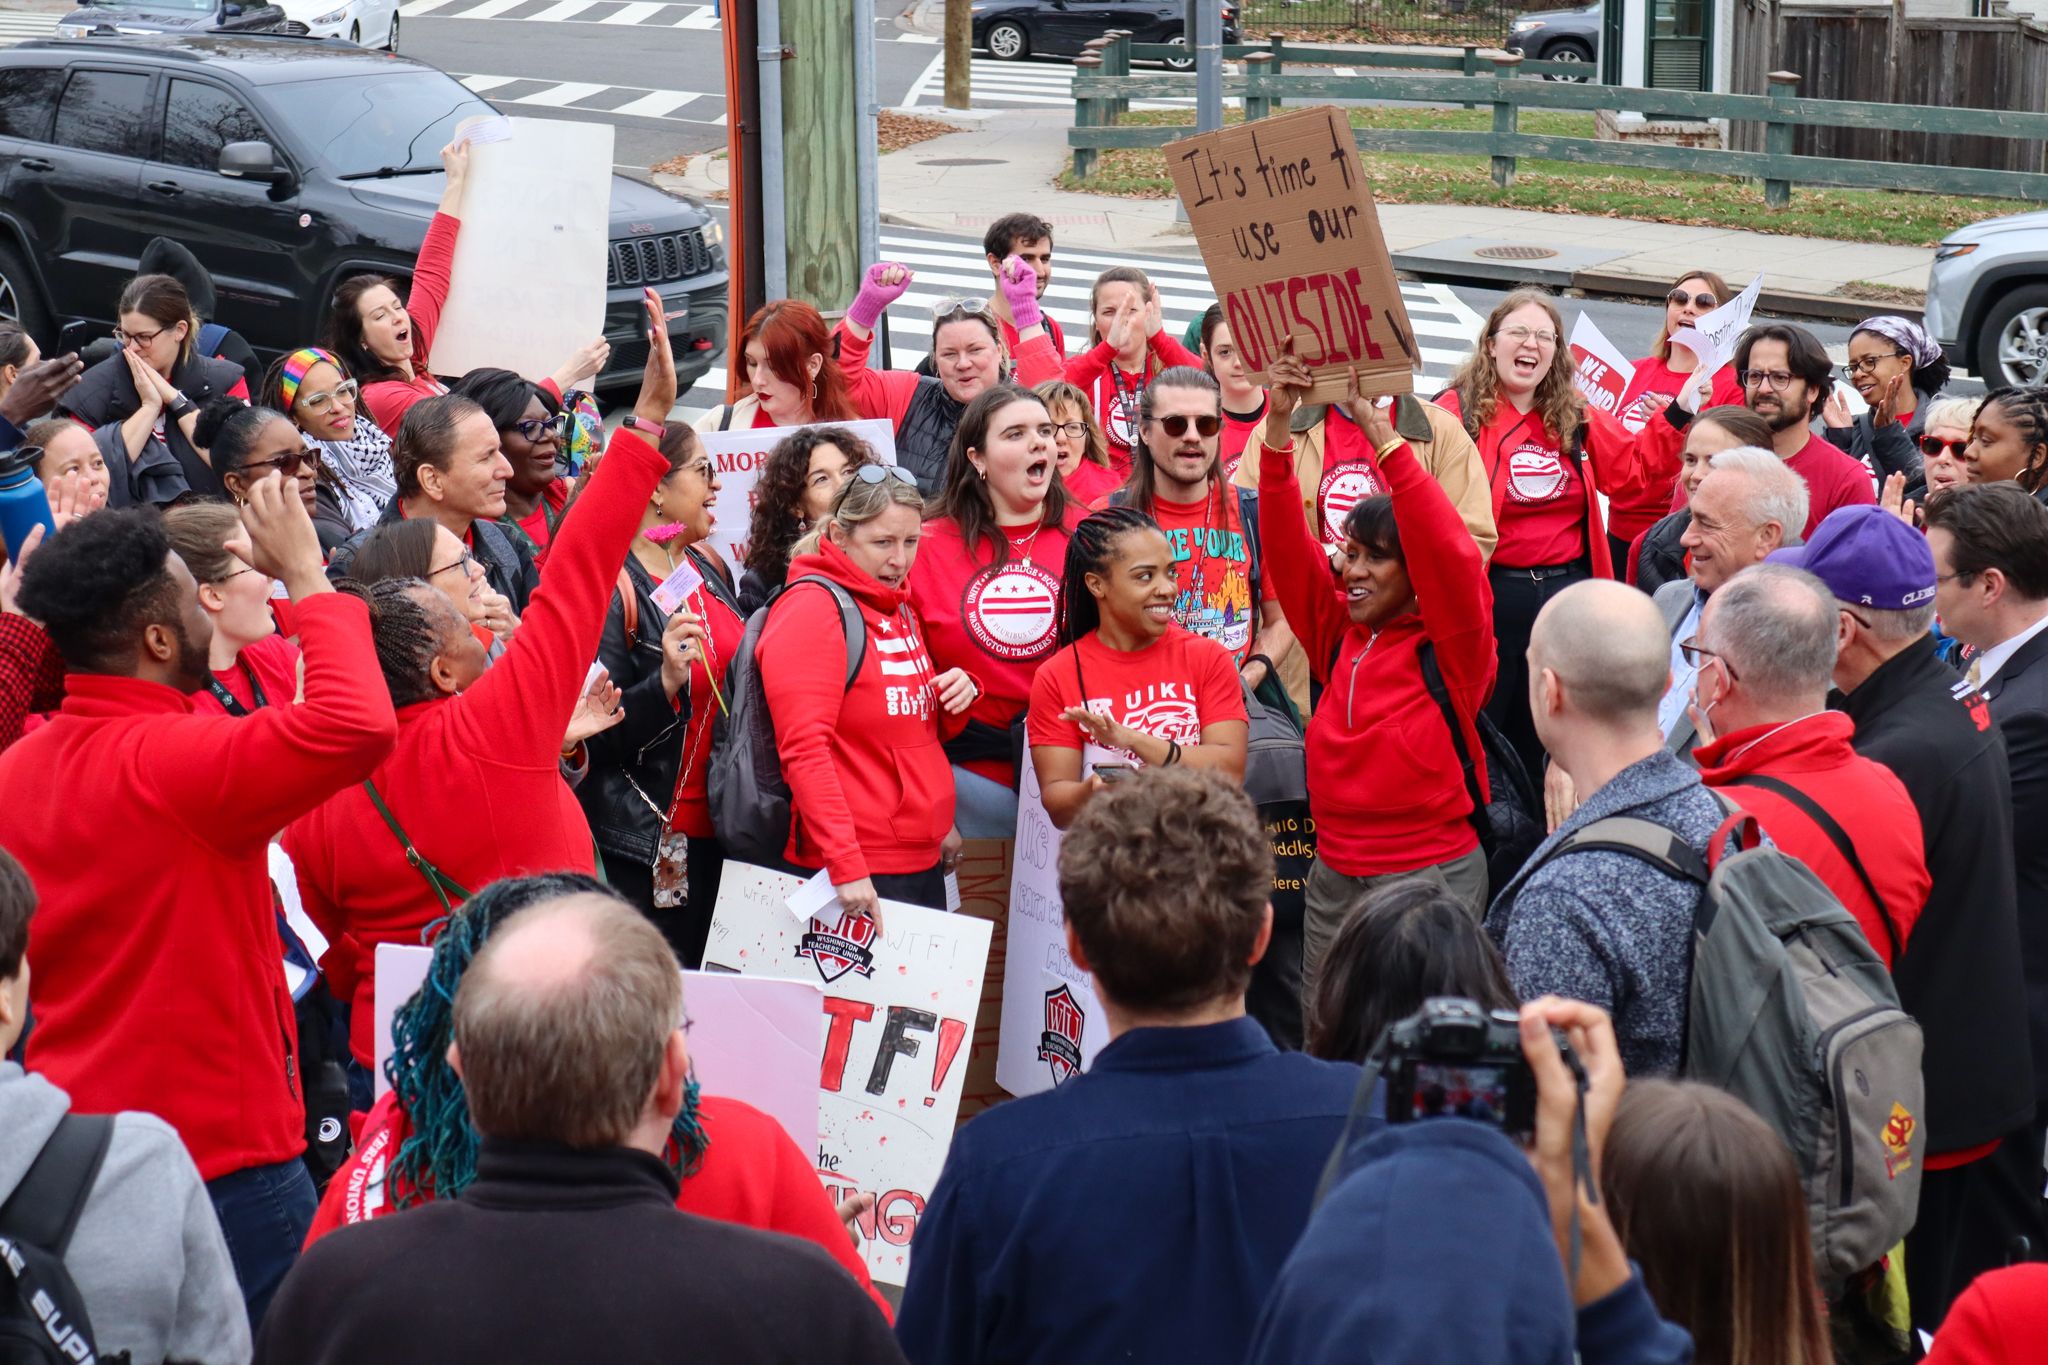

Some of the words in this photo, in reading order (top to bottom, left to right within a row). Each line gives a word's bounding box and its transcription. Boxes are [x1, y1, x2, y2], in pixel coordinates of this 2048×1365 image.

[1182, 148, 1247, 208] It's
[1251, 130, 1316, 198] time
[1232, 220, 1280, 262] use
[1308, 204, 1358, 244] our
[1226, 267, 1384, 373] OUTSIDE
[1581, 354, 1608, 382] WE
[1193, 527, 1246, 562] YOUR
[967, 579, 983, 605] UNITY
[968, 610, 1010, 656] WASHINGTON
[885, 686, 913, 701] ST.
[816, 935, 859, 954] WASHINGTON
[842, 949, 864, 963] UNION
[887, 929, 958, 960] WTF!
[1049, 998, 1080, 1043] WTU
[345, 1167, 368, 1225] UNION
